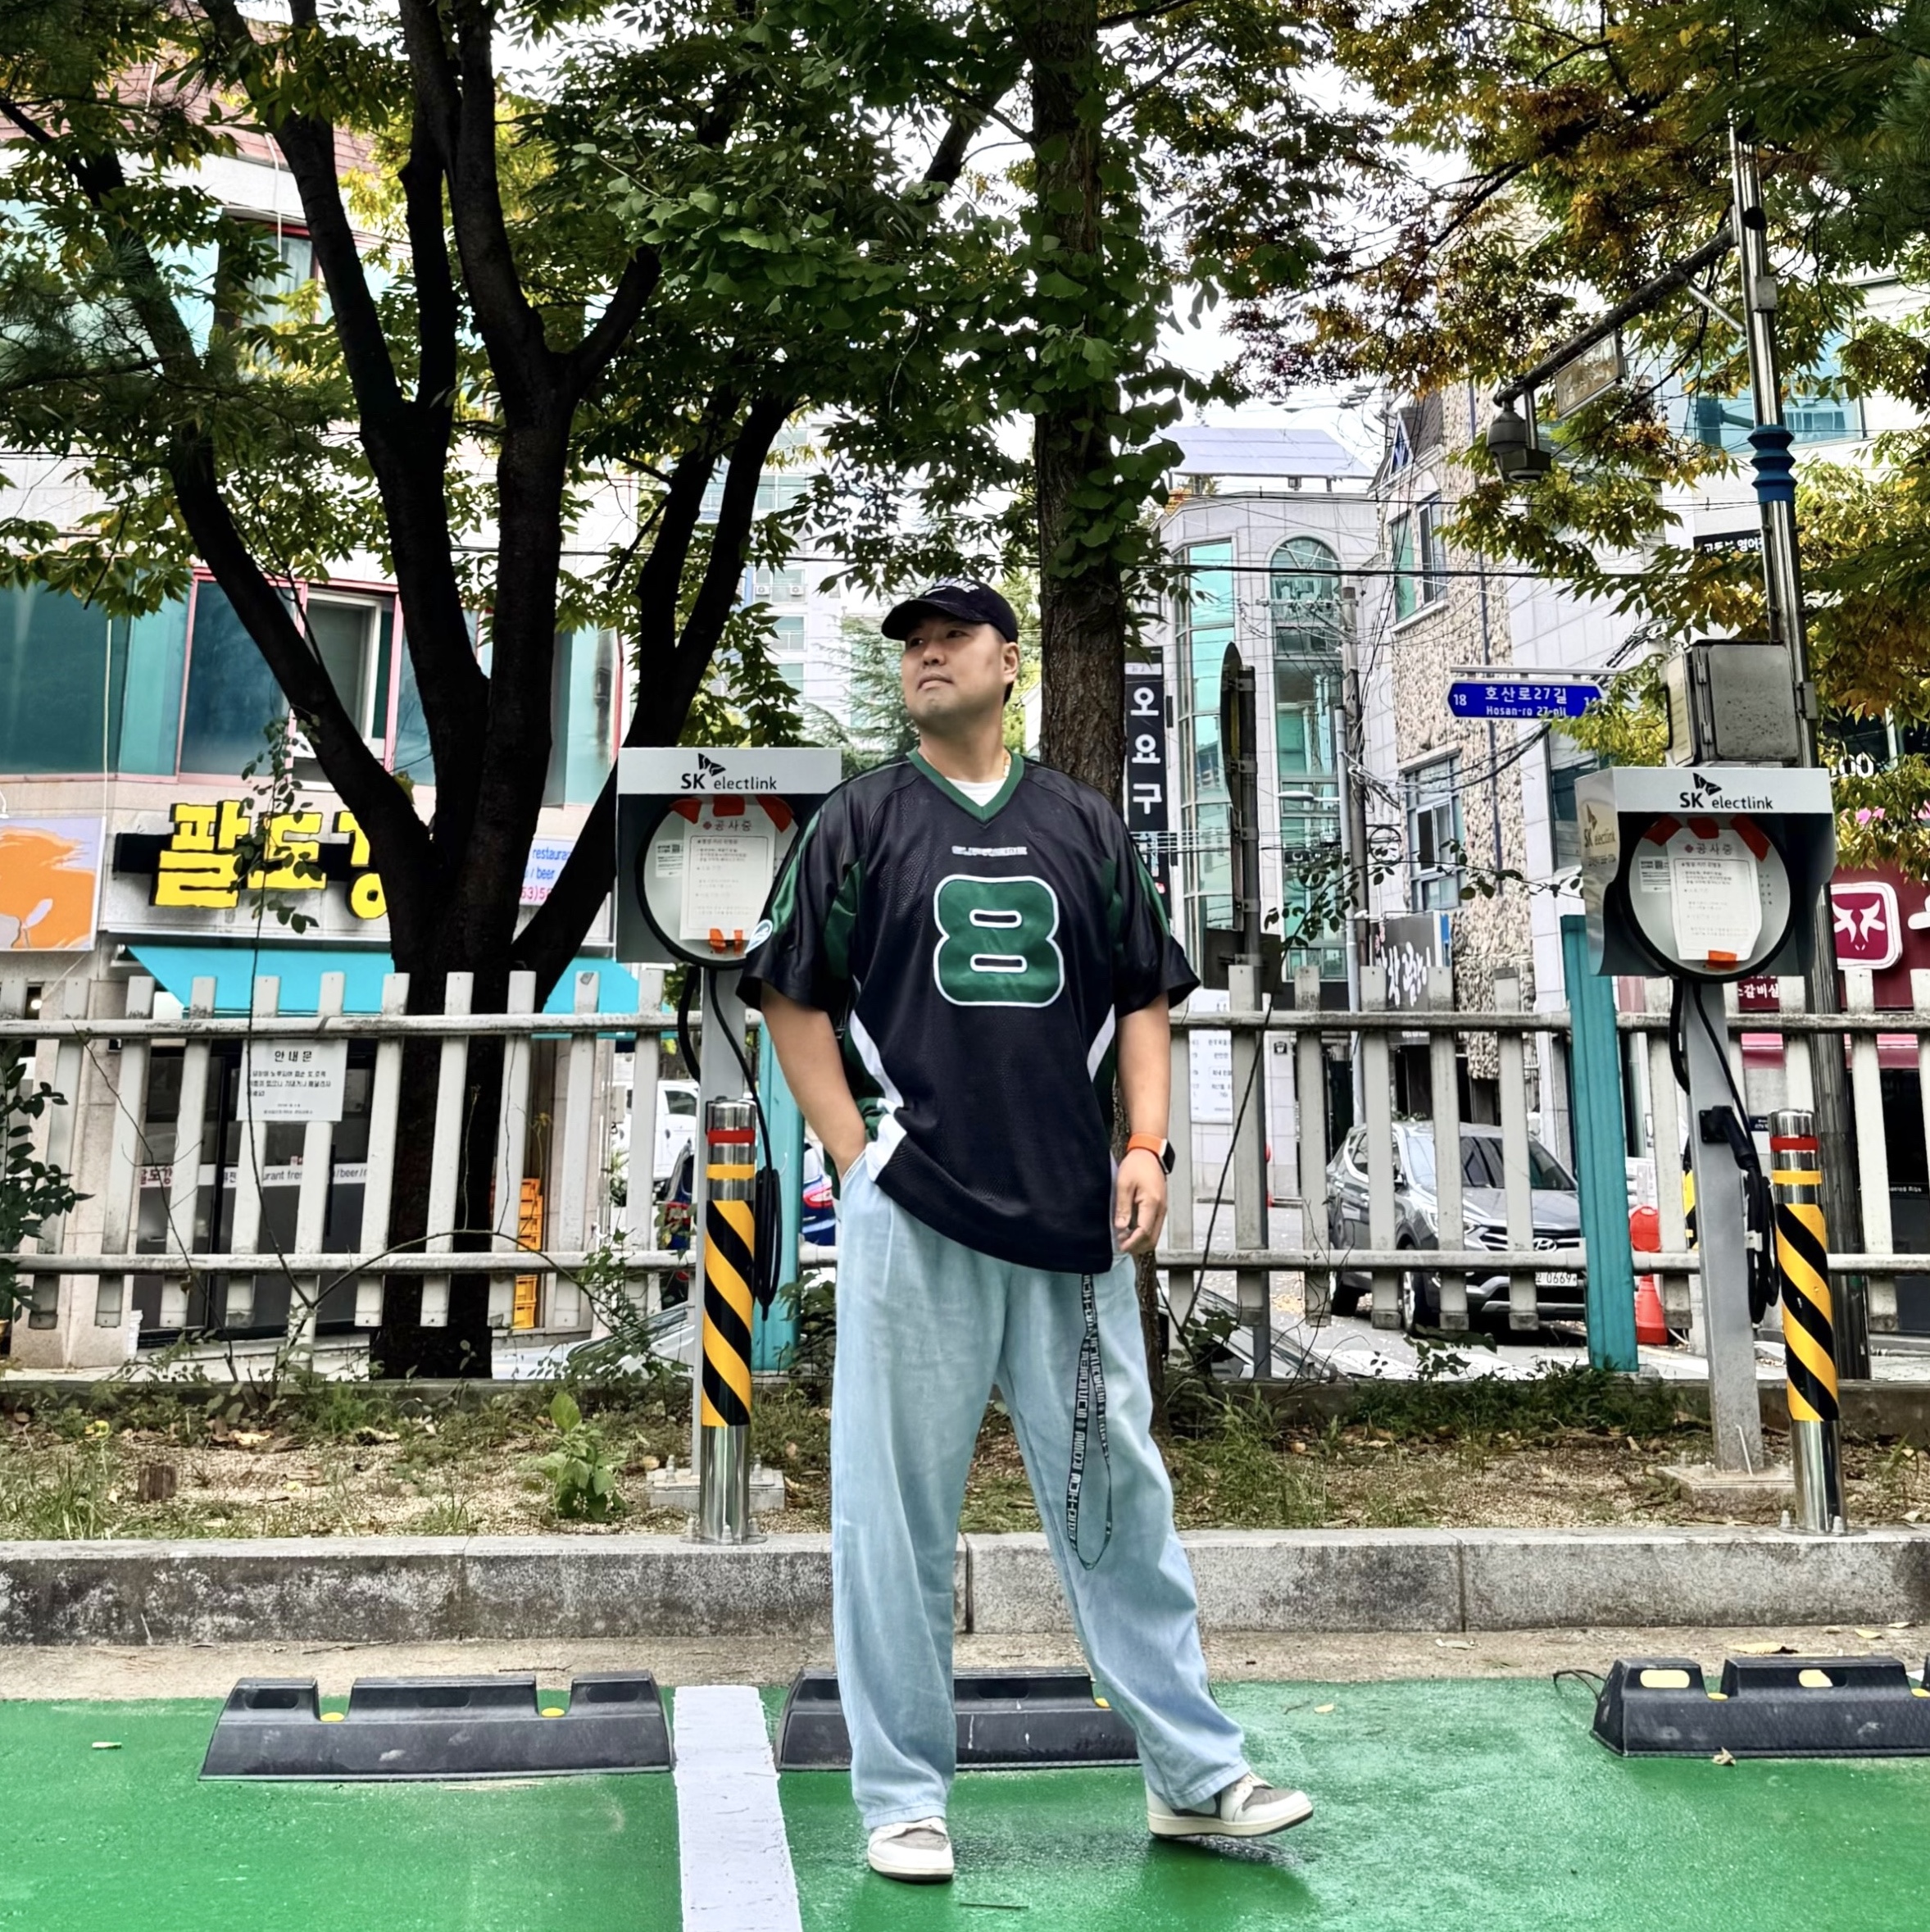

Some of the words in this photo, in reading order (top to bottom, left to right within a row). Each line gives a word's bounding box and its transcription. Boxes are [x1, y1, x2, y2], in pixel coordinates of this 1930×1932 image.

[1453, 693, 1467, 706] 18
[1484, 686, 1567, 705] 호산로27길
[1486, 706, 1533, 716] Hosan-ro
[1129, 686, 1162, 814] 오요구
[680, 773, 706, 789] SK
[713, 776, 777, 789] electlink
[1680, 792, 1704, 808] SK
[1712, 793, 1773, 810] electlink
[536, 866, 555, 880] beer
[933, 874, 1064, 1007] 8
[1546, 1272, 1571, 1284] 0669
